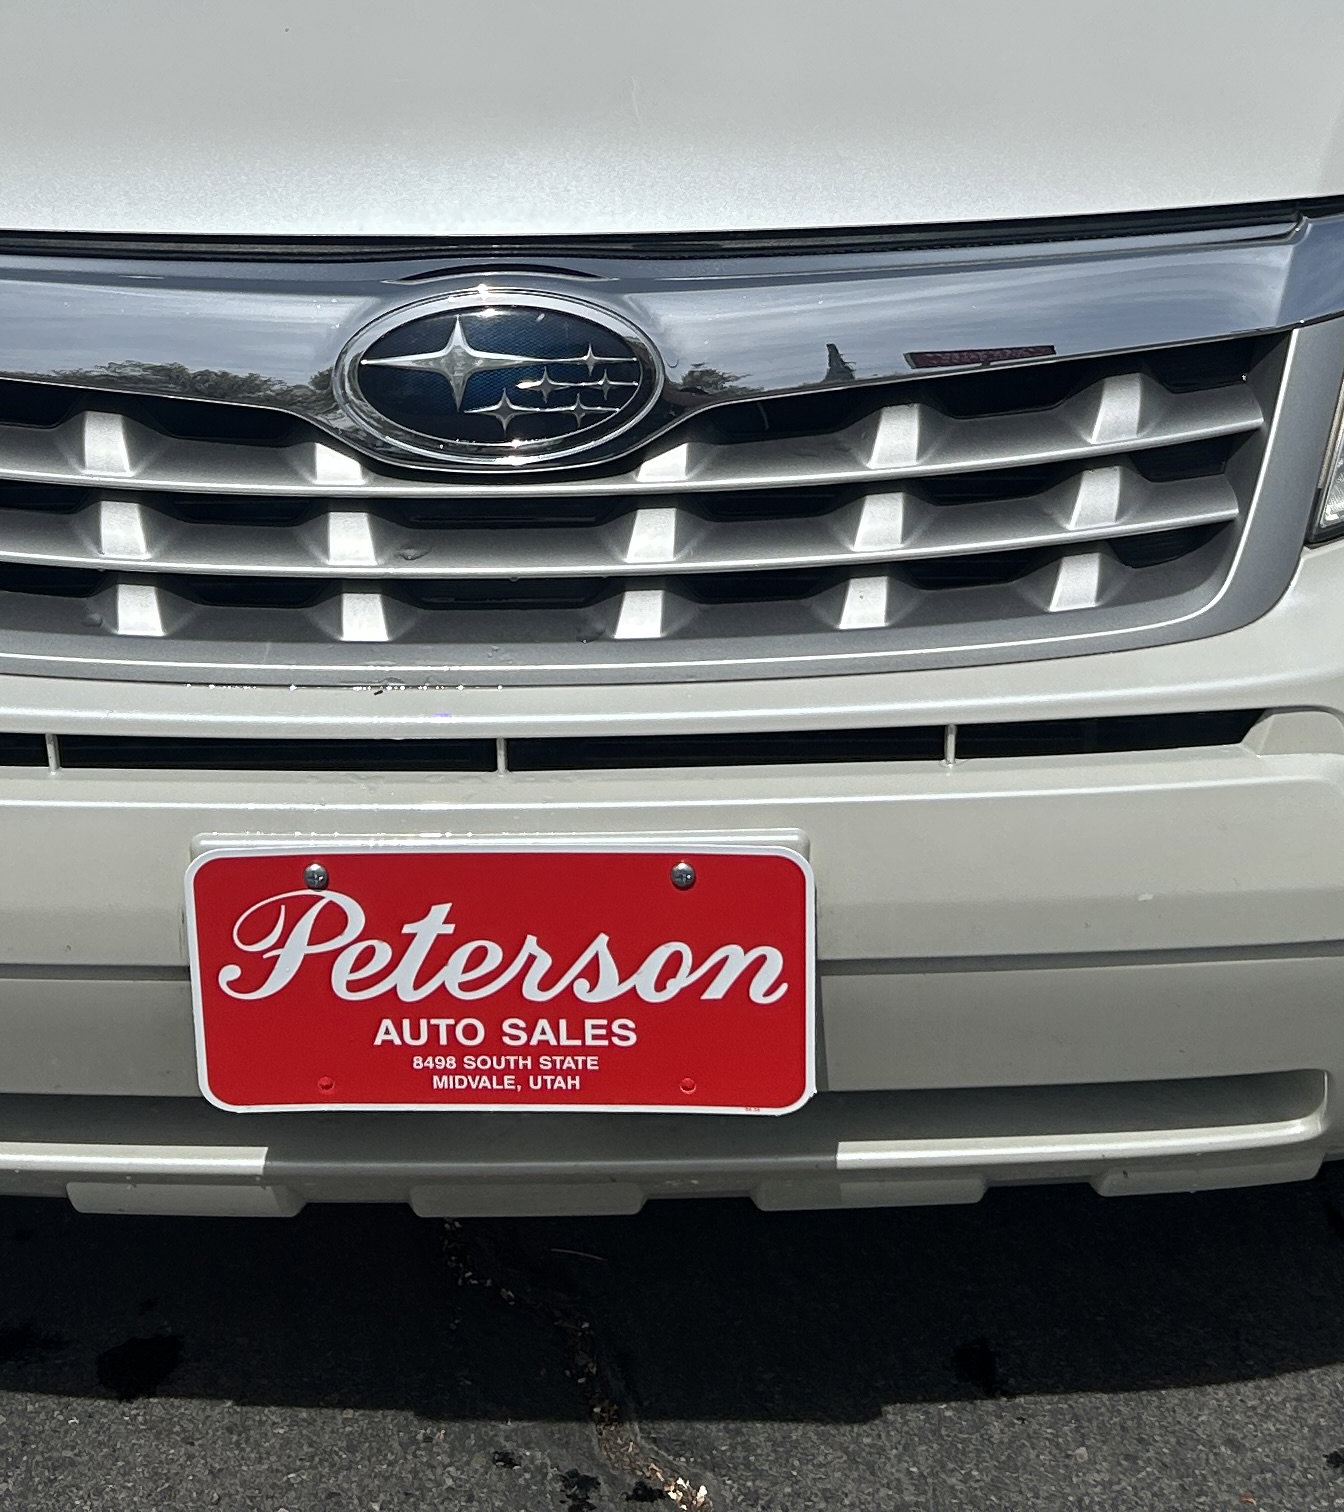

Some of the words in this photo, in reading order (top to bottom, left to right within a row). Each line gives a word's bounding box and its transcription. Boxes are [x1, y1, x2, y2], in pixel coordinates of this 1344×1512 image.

[219, 889, 789, 1004] Peterson
[373, 1018, 486, 1046] AUTO
[501, 1018, 638, 1047] SALES
[412, 1055, 457, 1070] 8498
[463, 1055, 532, 1070] SOUTH
[539, 1055, 600, 1070] STATE
[432, 1075, 523, 1093] MIDVALE,
[529, 1075, 581, 1090] UTAH
